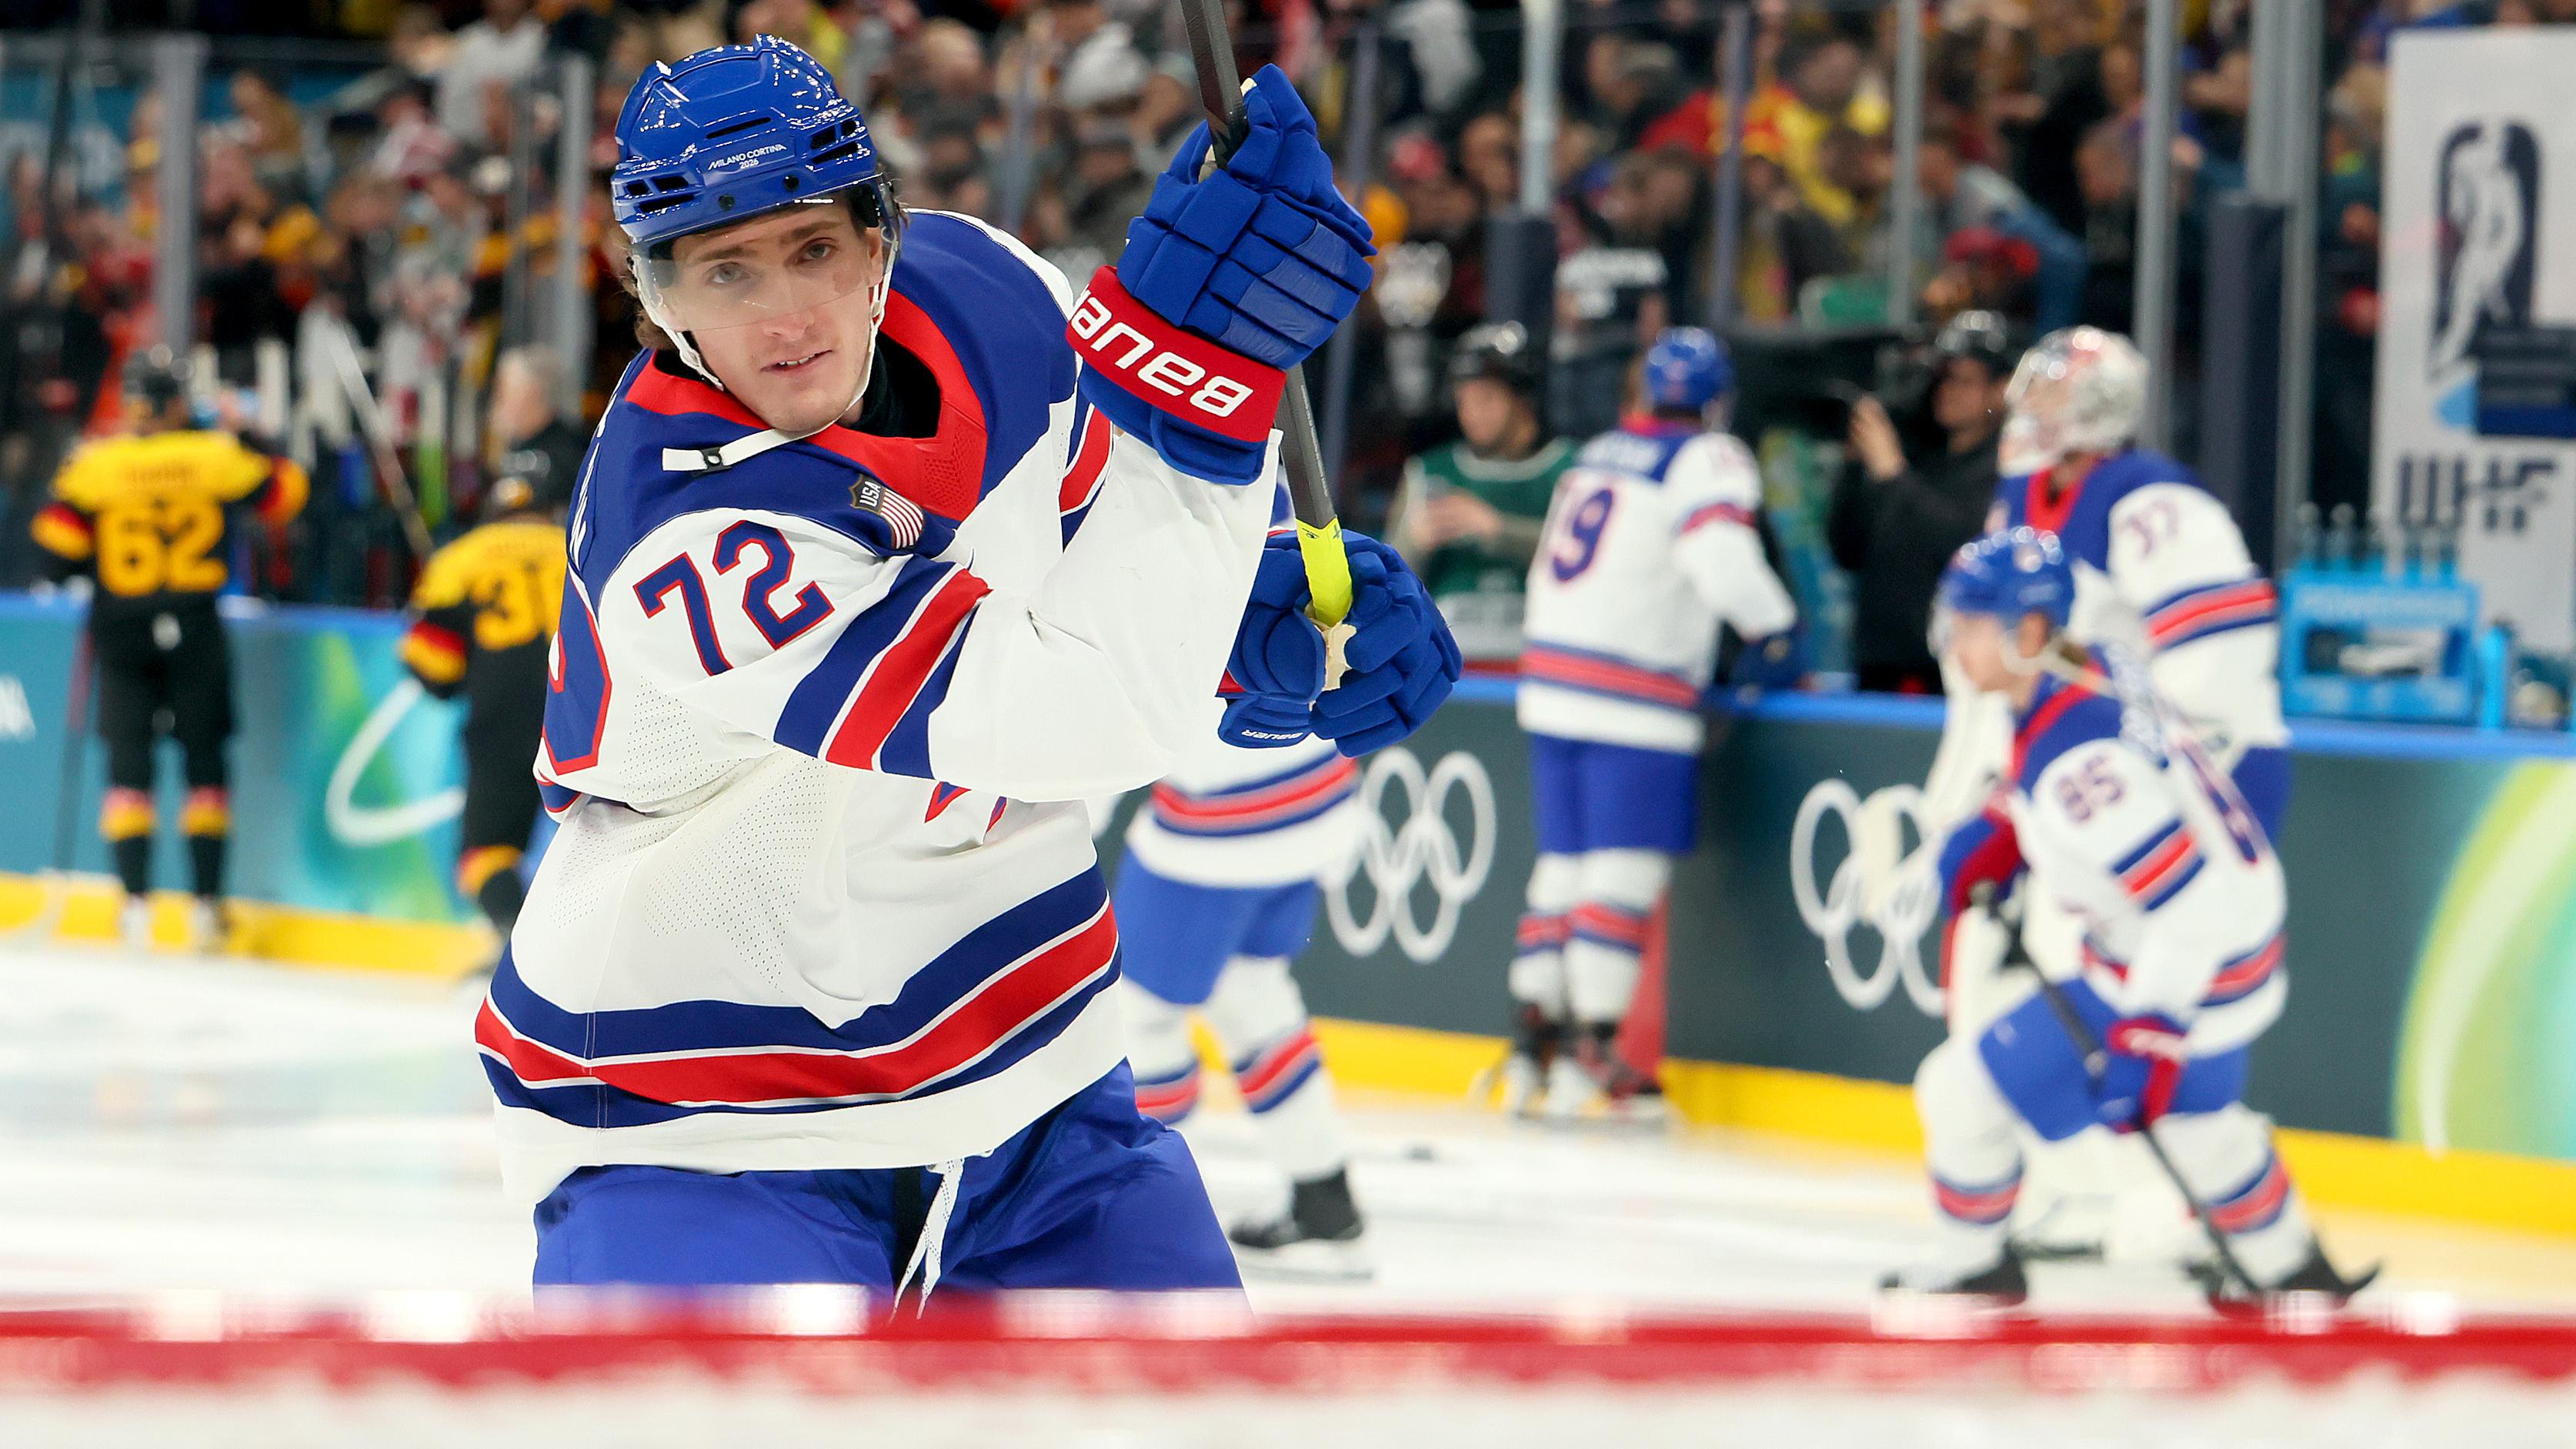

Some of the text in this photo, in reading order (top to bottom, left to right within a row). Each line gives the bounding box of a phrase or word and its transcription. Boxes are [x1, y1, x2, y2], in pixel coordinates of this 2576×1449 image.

[708, 143, 787, 170] MILANO CORTINA
[739, 158, 759, 169] 2026
[859, 480, 882, 508] USA
[96, 502, 229, 597] 62
[632, 519, 836, 677] 72
